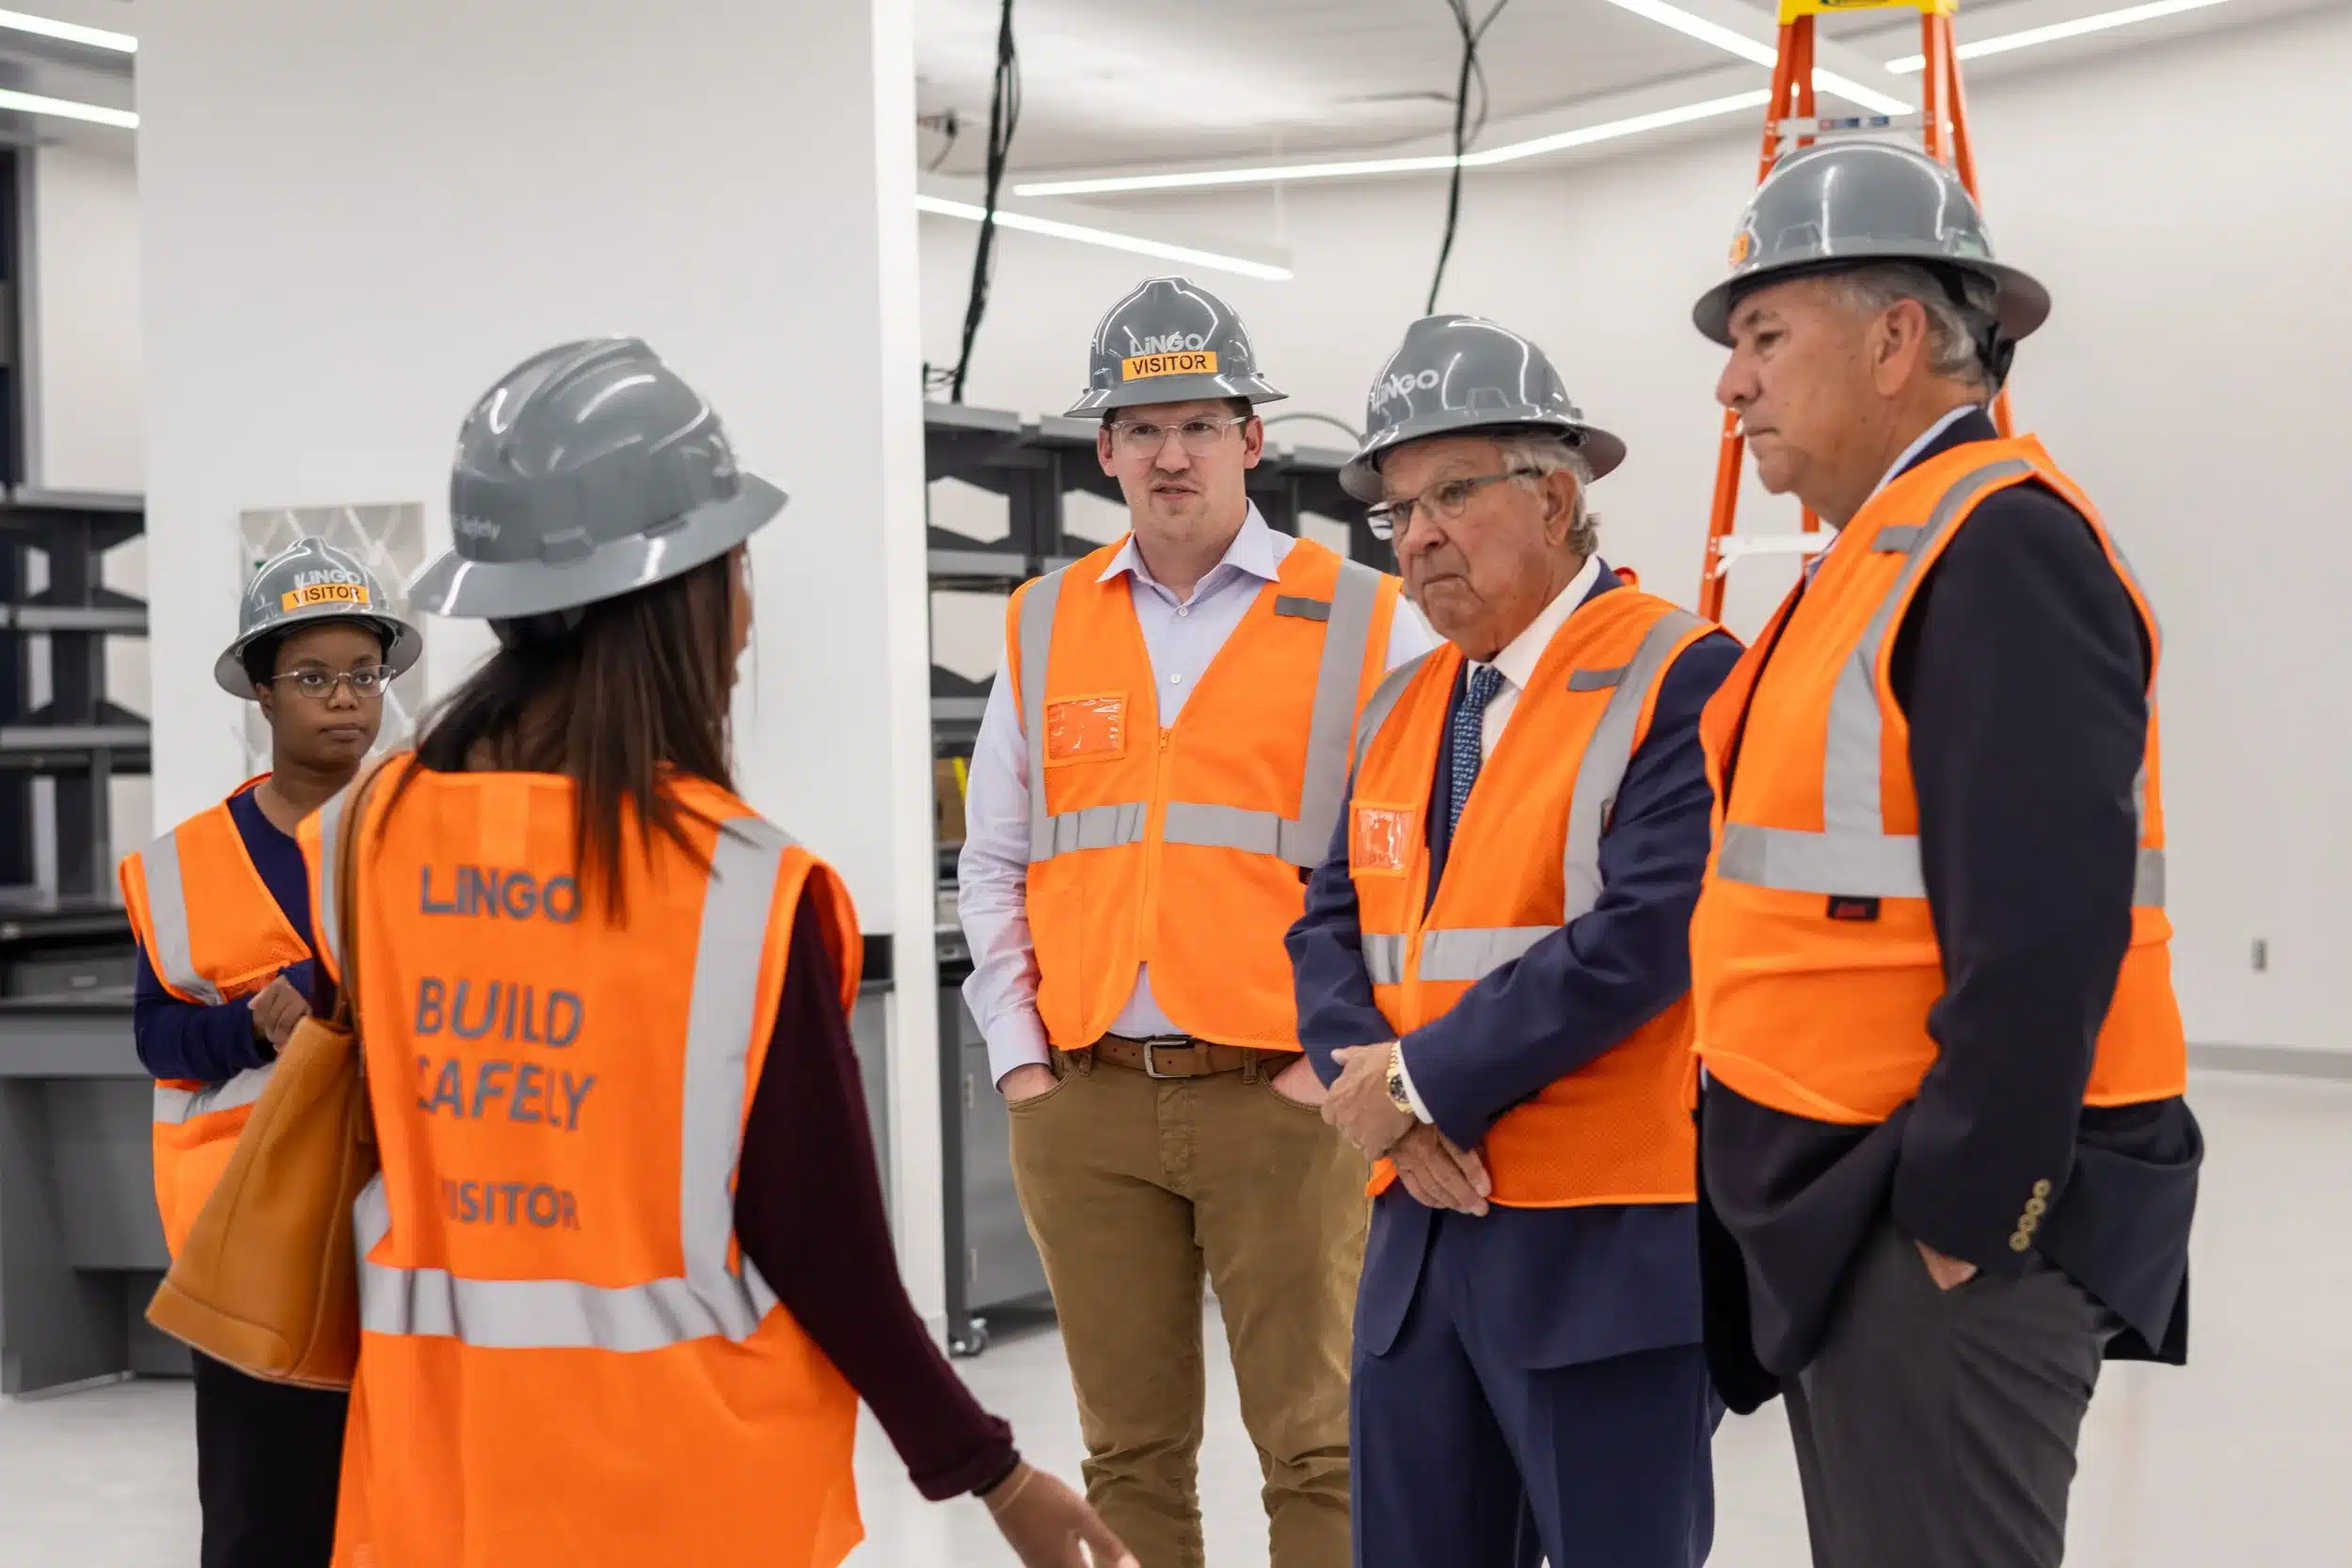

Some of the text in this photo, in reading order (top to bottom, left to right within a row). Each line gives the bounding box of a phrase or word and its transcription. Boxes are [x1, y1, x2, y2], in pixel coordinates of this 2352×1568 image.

[1129, 333, 1204, 356] LINGO
[1132, 355, 1207, 375] VISITOR
[293, 586, 361, 604] VISITOR
[420, 863, 581, 924] LINGO
[416, 976, 583, 1049] BUILD
[443, 1180, 580, 1231] ISITOR
